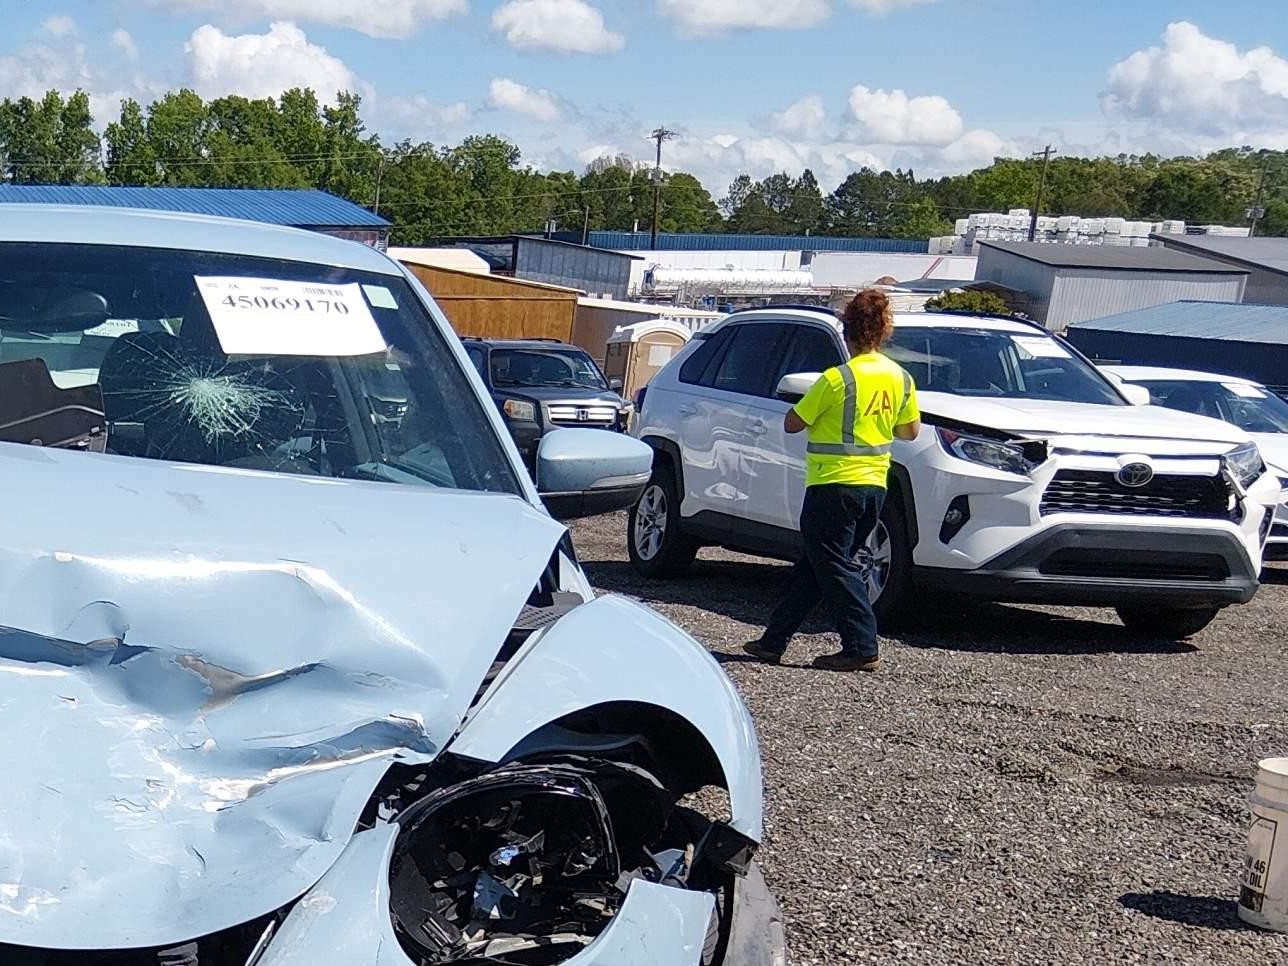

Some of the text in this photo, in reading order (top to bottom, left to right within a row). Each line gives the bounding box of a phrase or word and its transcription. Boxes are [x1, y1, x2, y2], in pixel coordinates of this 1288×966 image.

[222, 295, 349, 315] 45069170
[1254, 859, 1266, 873] 46
[1250, 872, 1262, 888] OIL
